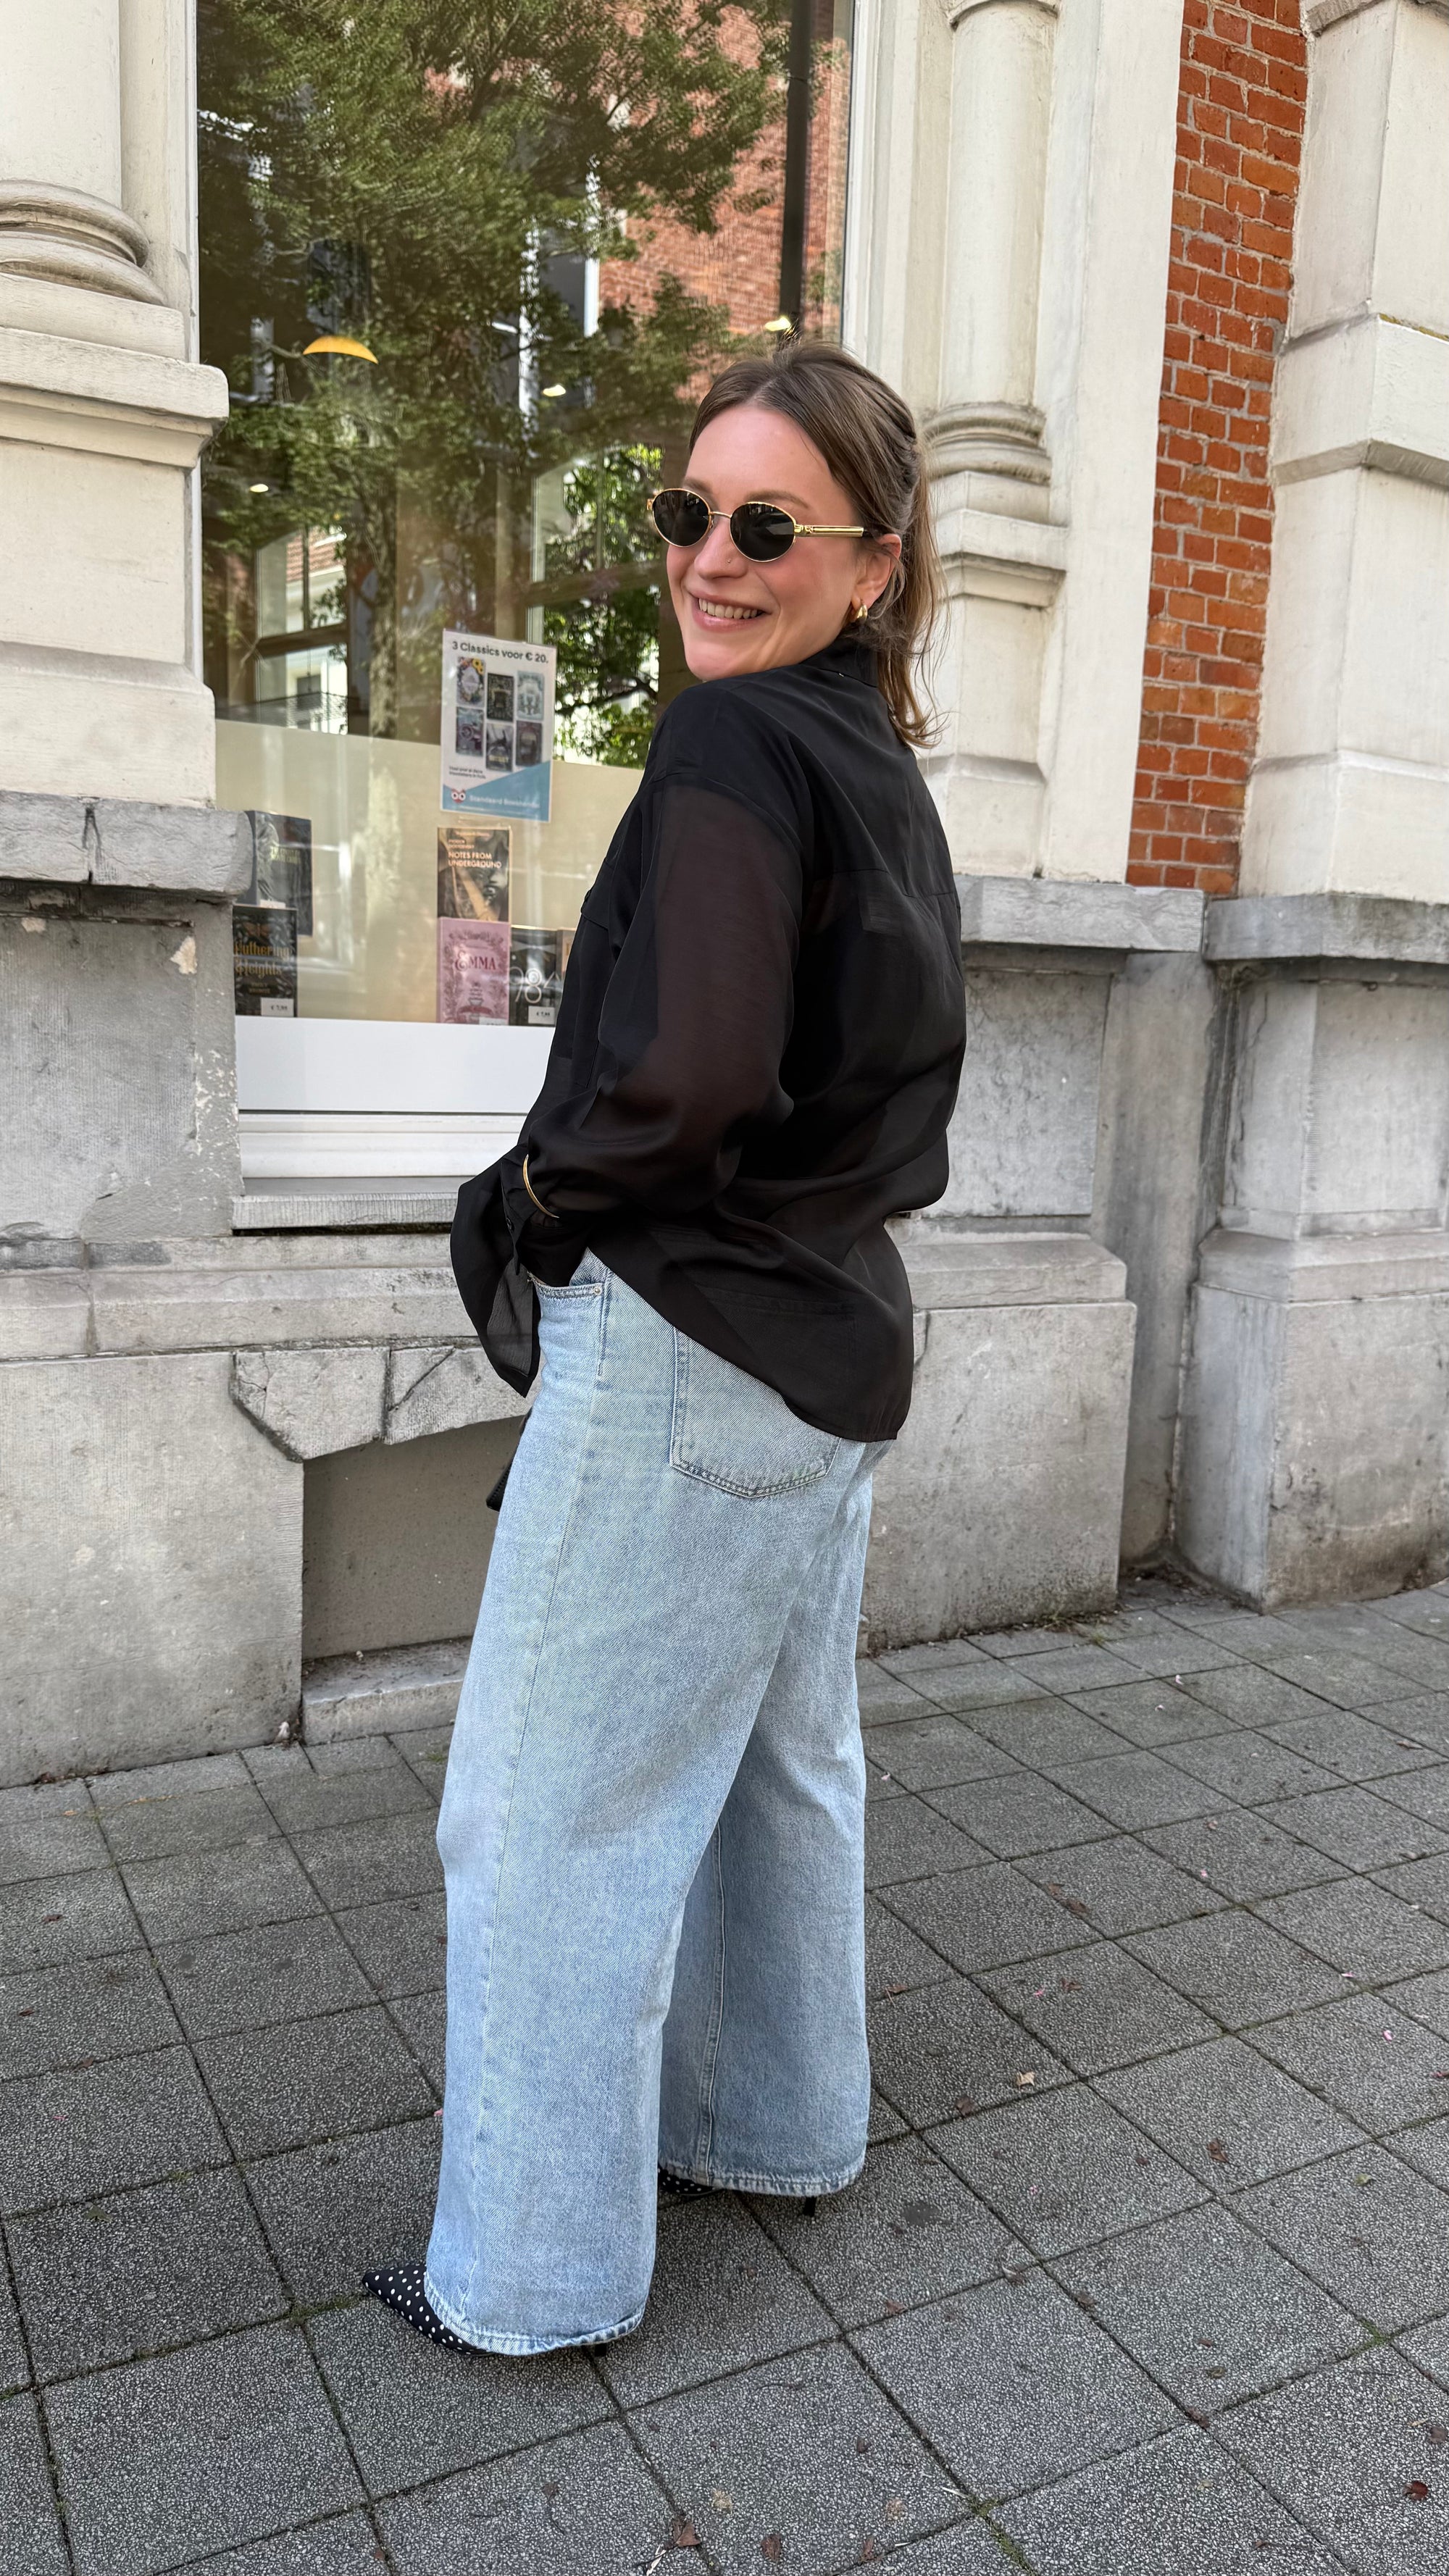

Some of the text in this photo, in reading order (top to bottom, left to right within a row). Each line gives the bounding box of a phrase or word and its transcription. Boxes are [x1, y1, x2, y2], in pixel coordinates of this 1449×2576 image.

[452, 641, 548, 664] 3 Classics voor € 20.
[448, 859, 502, 869] UNDERGROUND
